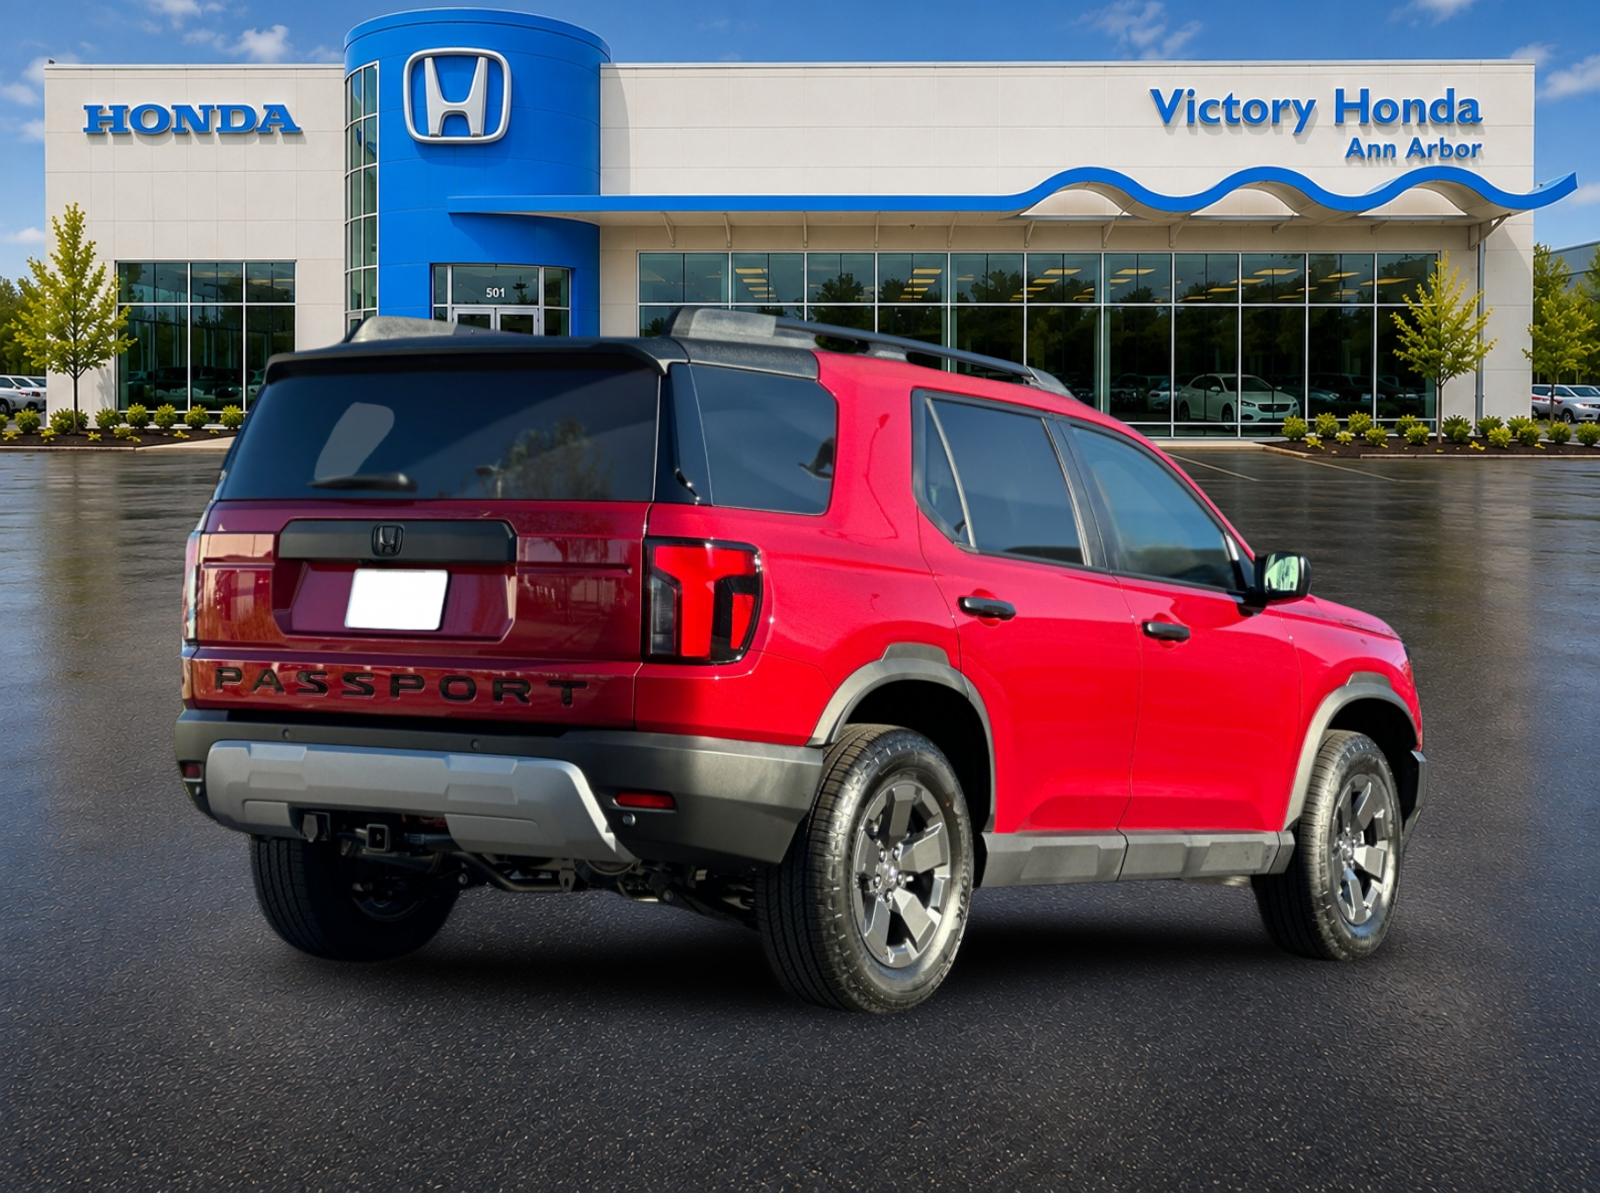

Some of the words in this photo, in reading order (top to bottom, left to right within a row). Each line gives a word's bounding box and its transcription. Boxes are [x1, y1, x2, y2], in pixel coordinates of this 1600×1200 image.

[83, 103, 303, 135] HONDA
[1150, 88, 1317, 136] Victory
[1334, 87, 1485, 126] Honda
[1345, 136, 1397, 160] Ann
[1406, 136, 1483, 160] Arbor
[485, 287, 505, 298] 501
[214, 667, 589, 707] PASSPORT
